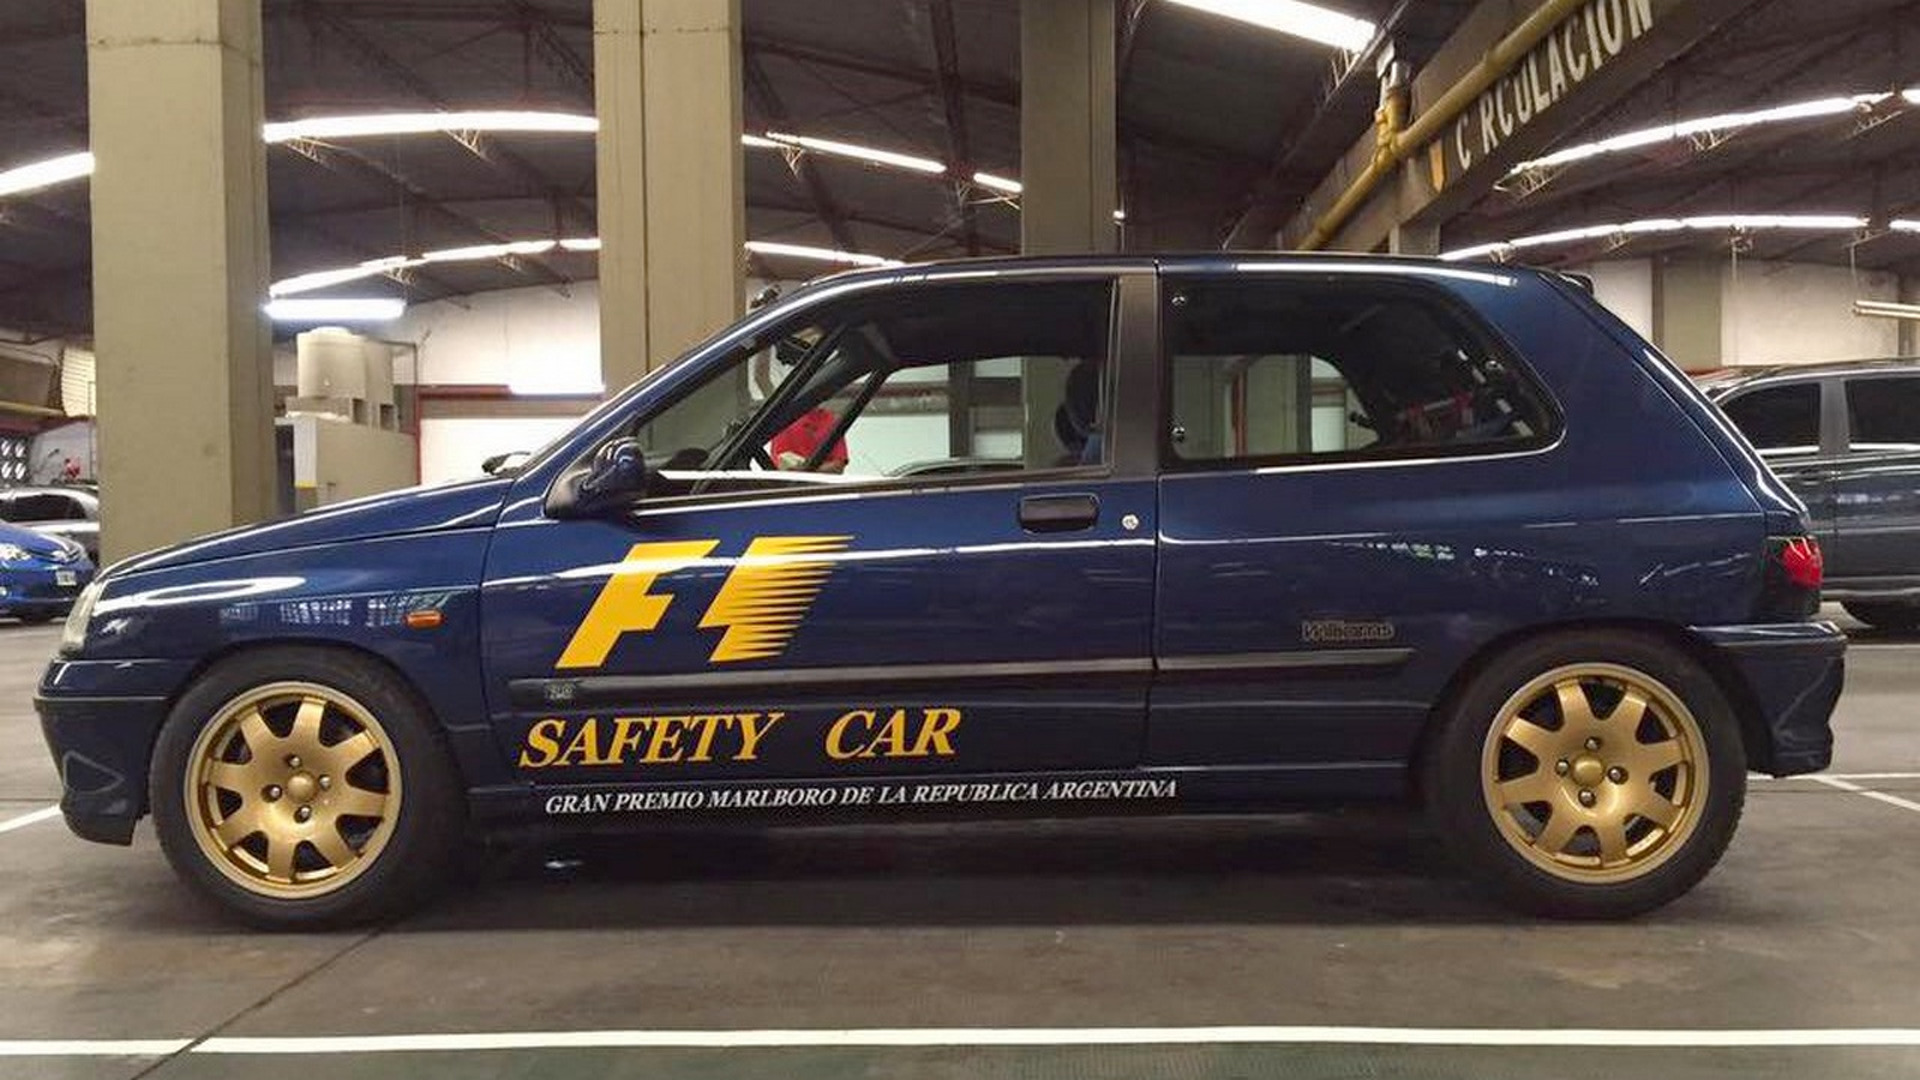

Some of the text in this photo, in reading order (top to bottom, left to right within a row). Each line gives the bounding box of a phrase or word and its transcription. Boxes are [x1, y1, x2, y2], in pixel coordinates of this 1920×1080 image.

[555, 535, 855, 669] F1
[519, 708, 961, 768] SAFETY CAR
[545, 779, 1177, 815] GRAN PREMIO MARLBORO DE LA REPUBLICA ARGENTINA
